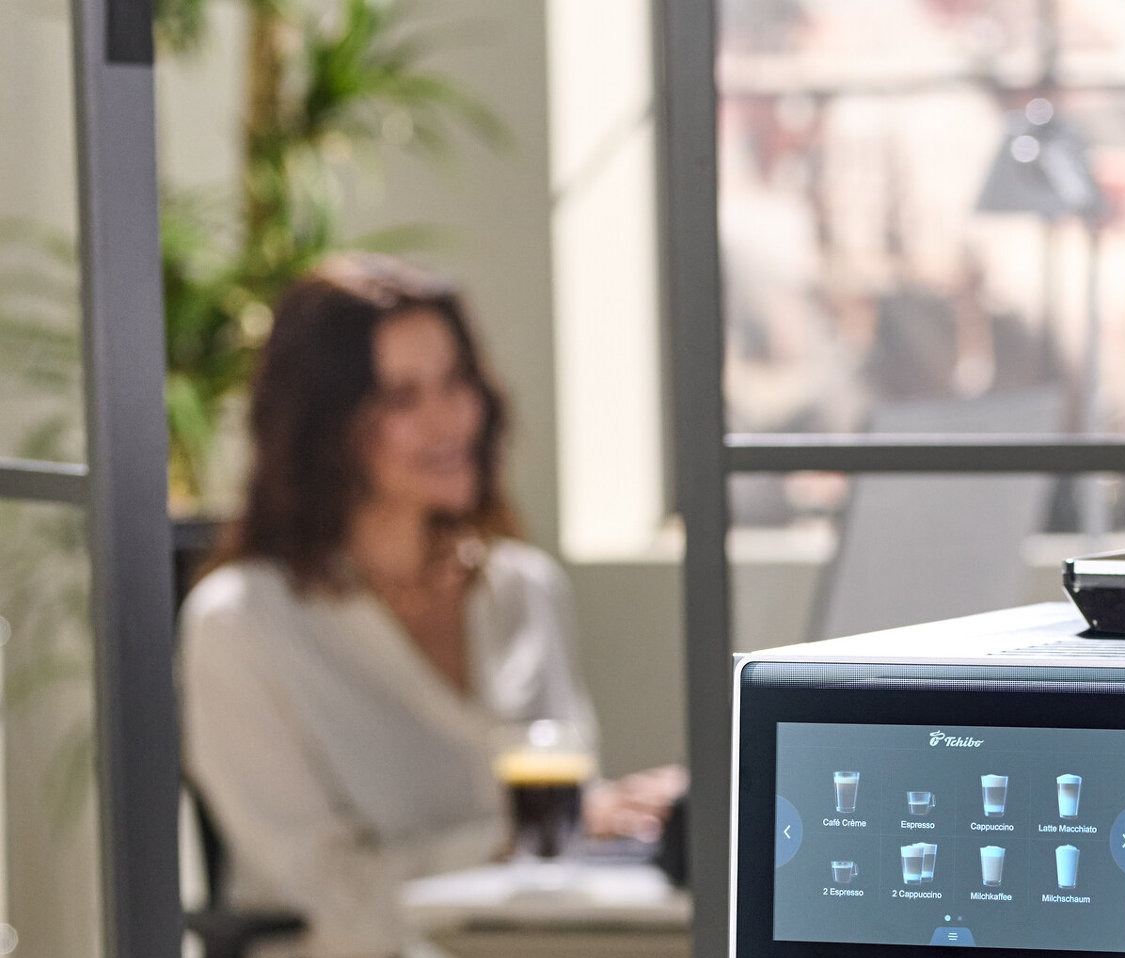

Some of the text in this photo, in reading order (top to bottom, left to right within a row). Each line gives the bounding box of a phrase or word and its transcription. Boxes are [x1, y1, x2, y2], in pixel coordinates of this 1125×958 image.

[944, 736, 984, 748] Tchibo
[823, 818, 867, 827] Café Crème
[901, 821, 935, 830] Espresso
[970, 822, 1014, 832] Cappuccino
[1038, 824, 1097, 834] Latte Macchiato
[823, 888, 864, 897] 2 Espresso
[892, 890, 942, 900] 2 Cappuccino
[970, 892, 1012, 901] Milchkaffee
[1042, 894, 1091, 903] Milchschaum
